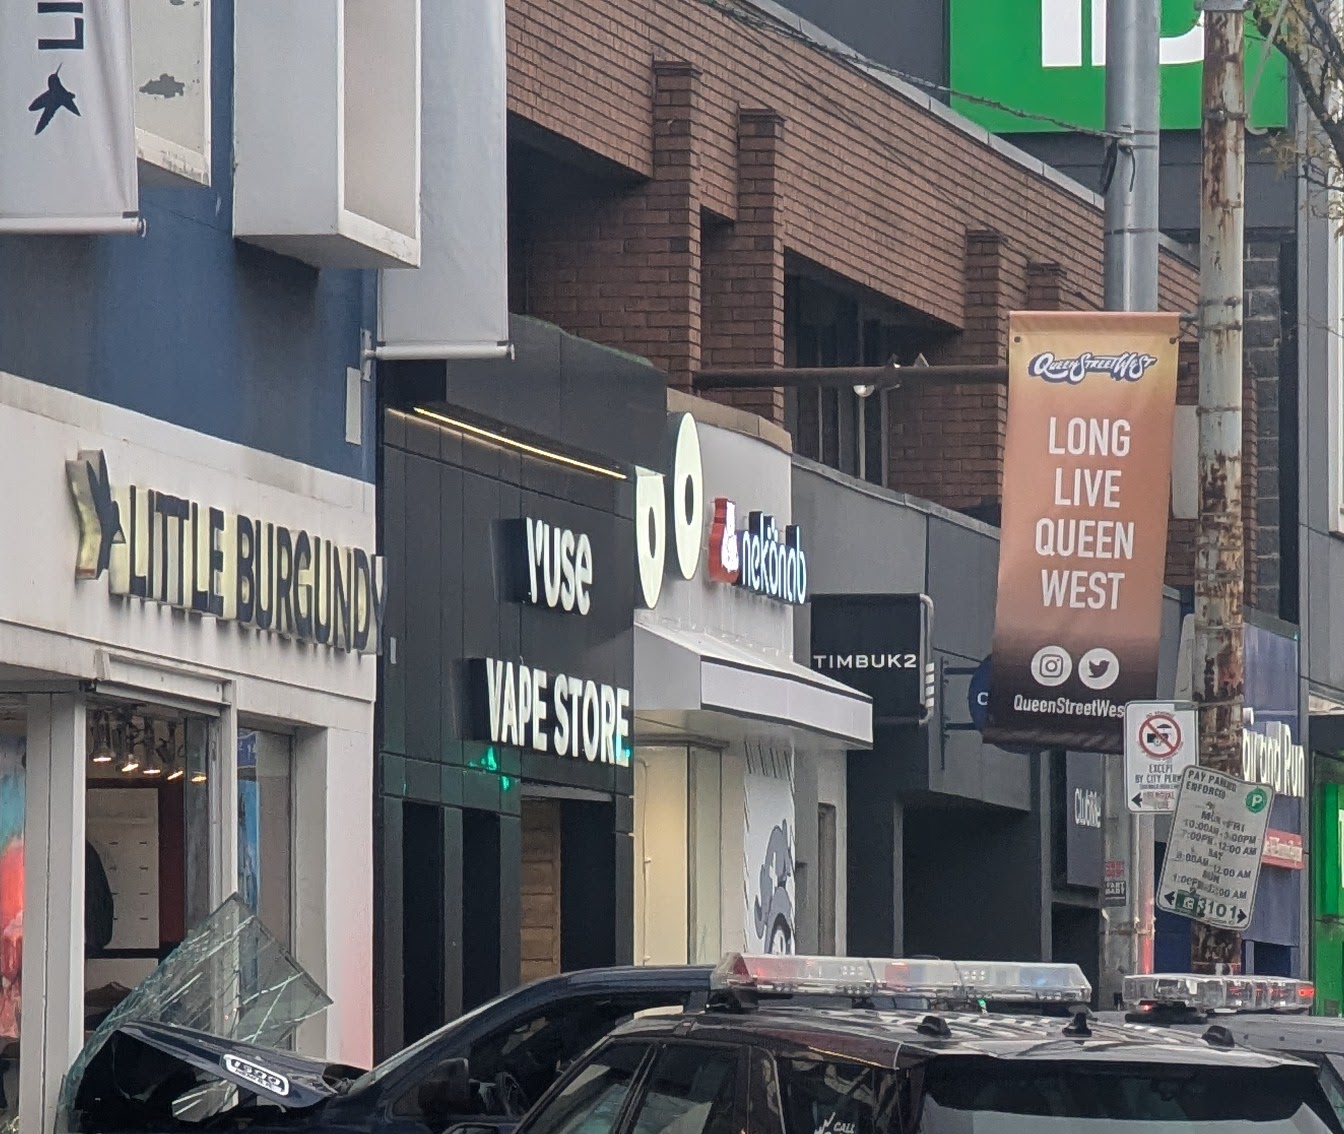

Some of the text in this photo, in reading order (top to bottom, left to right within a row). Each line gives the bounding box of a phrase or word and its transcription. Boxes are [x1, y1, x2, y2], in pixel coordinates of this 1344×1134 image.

[1049, 416, 1131, 457] LONG
[1054, 467, 1123, 508] LIVE
[1035, 518, 1135, 560] QUEEN
[129, 484, 387, 656] LITTLE BURGUNDY
[1040, 569, 1126, 610] WEST
[813, 654, 917, 669] TIMBUK2
[486, 657, 632, 768] VAPE STORE
[1188, 769, 1206, 782] PAY
